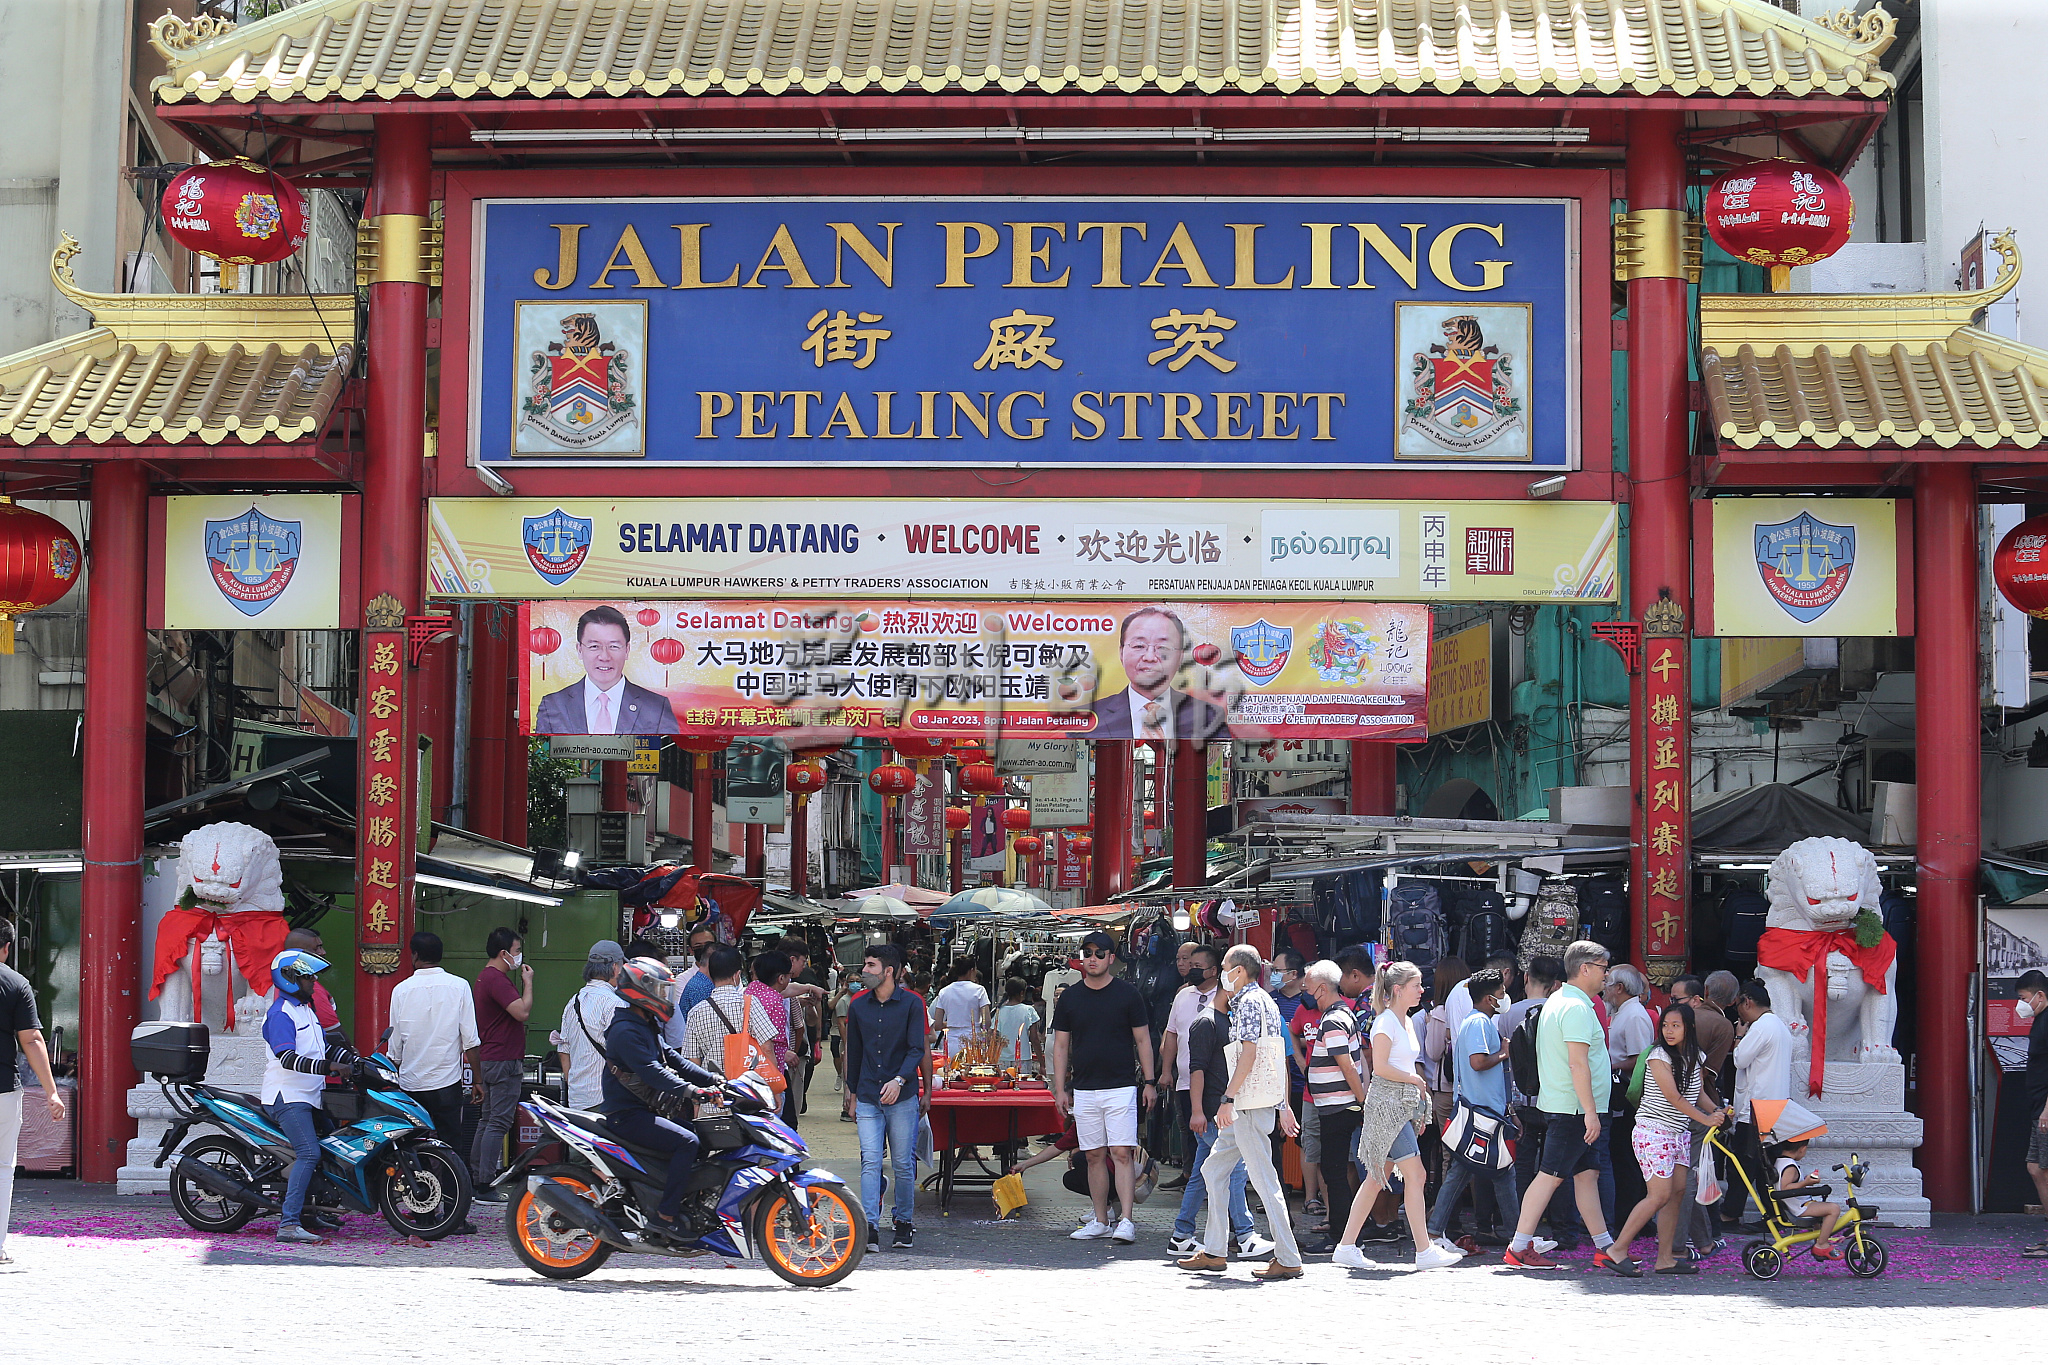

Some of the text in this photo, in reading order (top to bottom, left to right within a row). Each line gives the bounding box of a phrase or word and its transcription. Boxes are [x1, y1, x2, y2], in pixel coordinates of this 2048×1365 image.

[533, 222, 1514, 292] JALAN PETALING
[695, 391, 1346, 441] PETALING STREET
[527, 414, 550, 432] Dewan
[588, 429, 607, 442] Kuala
[607, 412, 632, 431] Lumpur
[1410, 415, 1517, 448] Dewan Bandaraya Kuala Lumpur
[619, 523, 859, 553] SELAMAT DATANG
[904, 524, 1040, 554] WELCOME
[1076, 528, 1222, 565] 欢迎光临
[1269, 530, 1391, 562] நல்வரவு
[1422, 515, 1447, 588] 丙申年
[229, 578, 278, 593] KUALA LUMPUR
[626, 577, 989, 589] KUALA LUMPUR HAWKERS' & PETTY TRADERS' ASSOCIATION
[1008, 578, 1127, 591] 吉隆坡小販商業公會
[1148, 579, 1375, 591] PERSATUAN PENJAJA DAN PENIAGA KECIL KUALA LUMPUR
[1781, 584, 1833, 599] KUALA LUMPUR
[240, 592, 259, 600] PETTY
[1793, 598, 1813, 606] PETTY
[676, 611, 853, 633] Selamat Datang
[882, 610, 978, 634] 热烈欢迎
[1008, 613, 1114, 632] Welcome
[697, 640, 1091, 669] 大马地方房屋发展部部长倪可敏及
[1443, 639, 1459, 667] BEG
[1379, 662, 1414, 674] LOONG
[1459, 662, 1474, 693] SDN.
[1474, 658, 1488, 688] BHD.
[737, 671, 1050, 700] 中国驻马大使阁下欧阳玉靖
[1382, 676, 1408, 685] KEE
[1228, 695, 1275, 704] PERSATUAN
[1277, 695, 1310, 705] PENJAJA
[1312, 695, 1330, 704] DAN
[1331, 695, 1367, 705] PENIAGA
[1367, 695, 1392, 705] KECIL
[686, 709, 716, 727] 主持
[917, 715, 1007, 727] 18 Jan 2023, 8pm
[1016, 716, 1089, 728] Jalan Petaling
[1243, 715, 1285, 724] HAWKERS'
[1286, 716, 1293, 724] &
[1294, 715, 1319, 724] PETTY
[1319, 715, 1358, 724] TRADERS'
[1359, 715, 1415, 724] ASSOCIATION
[552, 745, 632, 758] www.zhen-ao.com.my
[1027, 742, 1042, 752] My
[1043, 742, 1068, 752] Glory
[1002, 757, 1076, 771] www.zhen-ao.com.my
